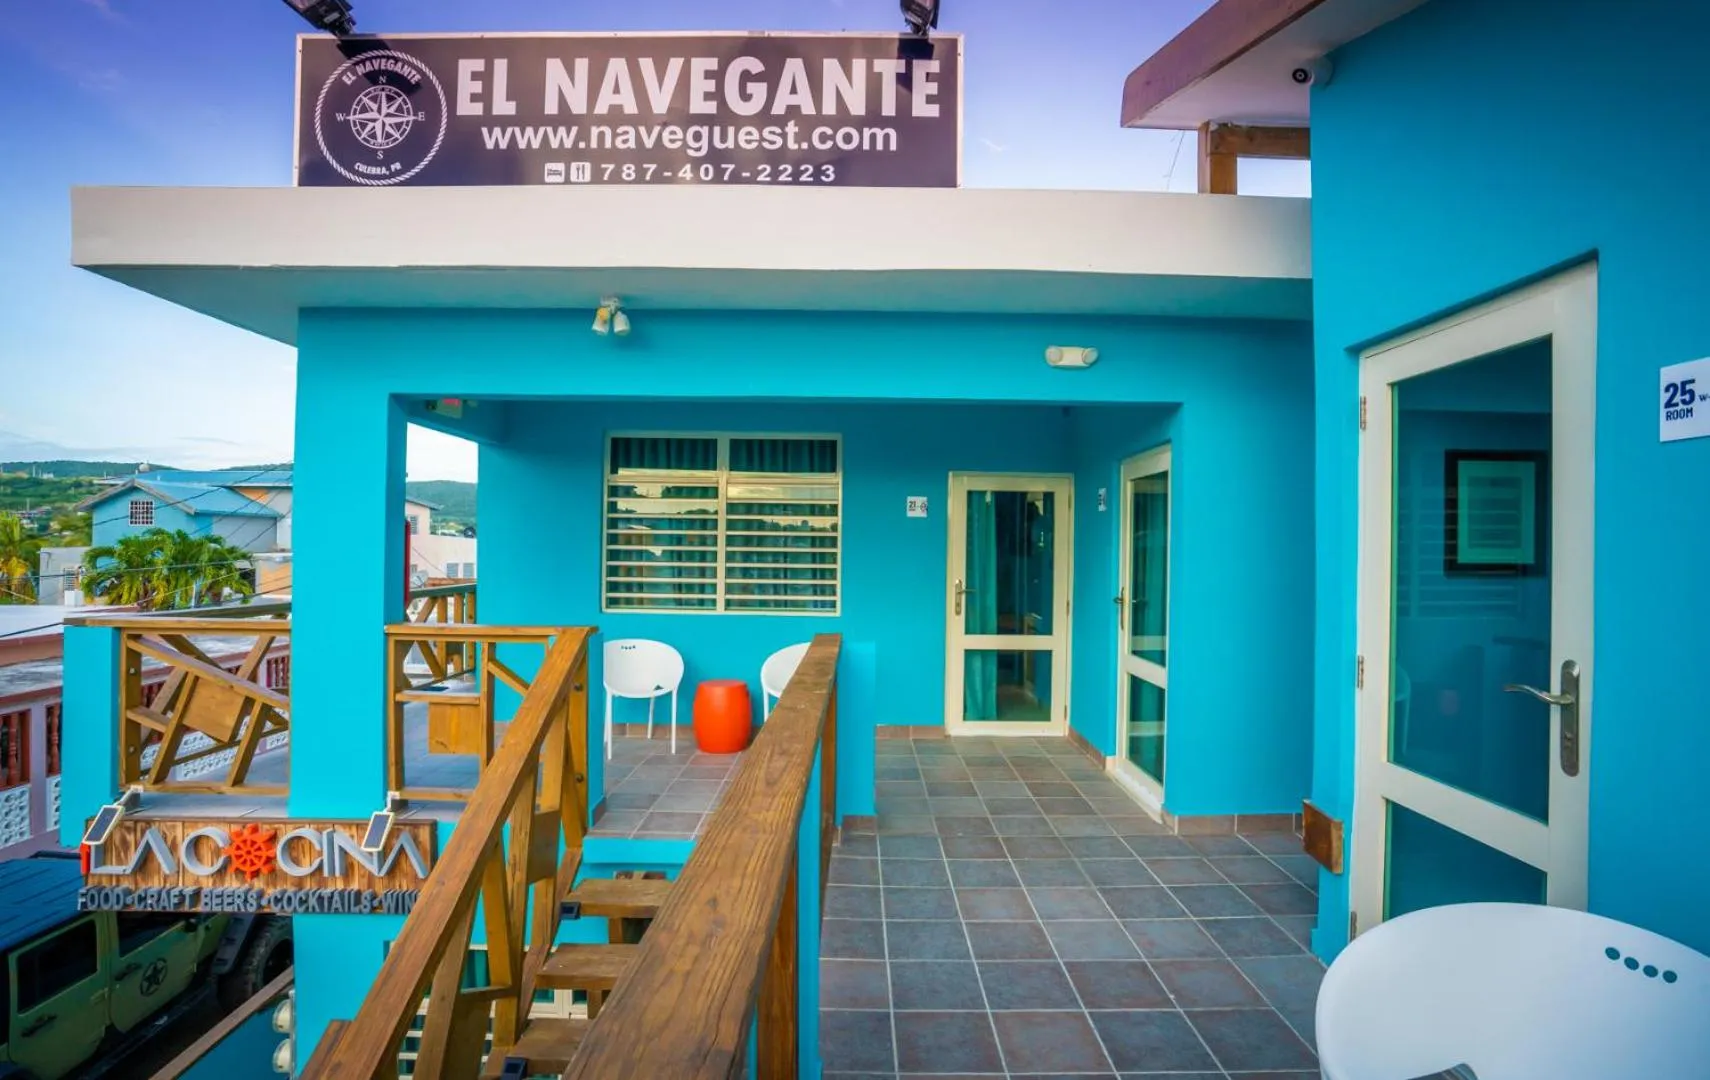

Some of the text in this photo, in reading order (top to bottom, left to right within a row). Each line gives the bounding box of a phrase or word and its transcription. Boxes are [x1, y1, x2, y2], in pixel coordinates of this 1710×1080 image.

[342, 58, 422, 86] EL NAVEGANTE
[379, 76, 387, 84] N
[456, 56, 941, 117] EL NAVEGANTE
[335, 112, 346, 122] W
[418, 112, 425, 121] E
[481, 120, 897, 156] www.naveguest.com
[376, 150, 384, 160] S
[391, 162, 402, 172] PR
[601, 163, 837, 182] 787-407-2223
[1664, 379, 1695, 409] 25
[1666, 407, 1693, 421] ROOM
[78, 887, 127, 911] FOOD
[133, 887, 195, 911] CRAFT
[201, 887, 258, 912] BEERS
[270, 889, 374, 914] COCKTAILS
